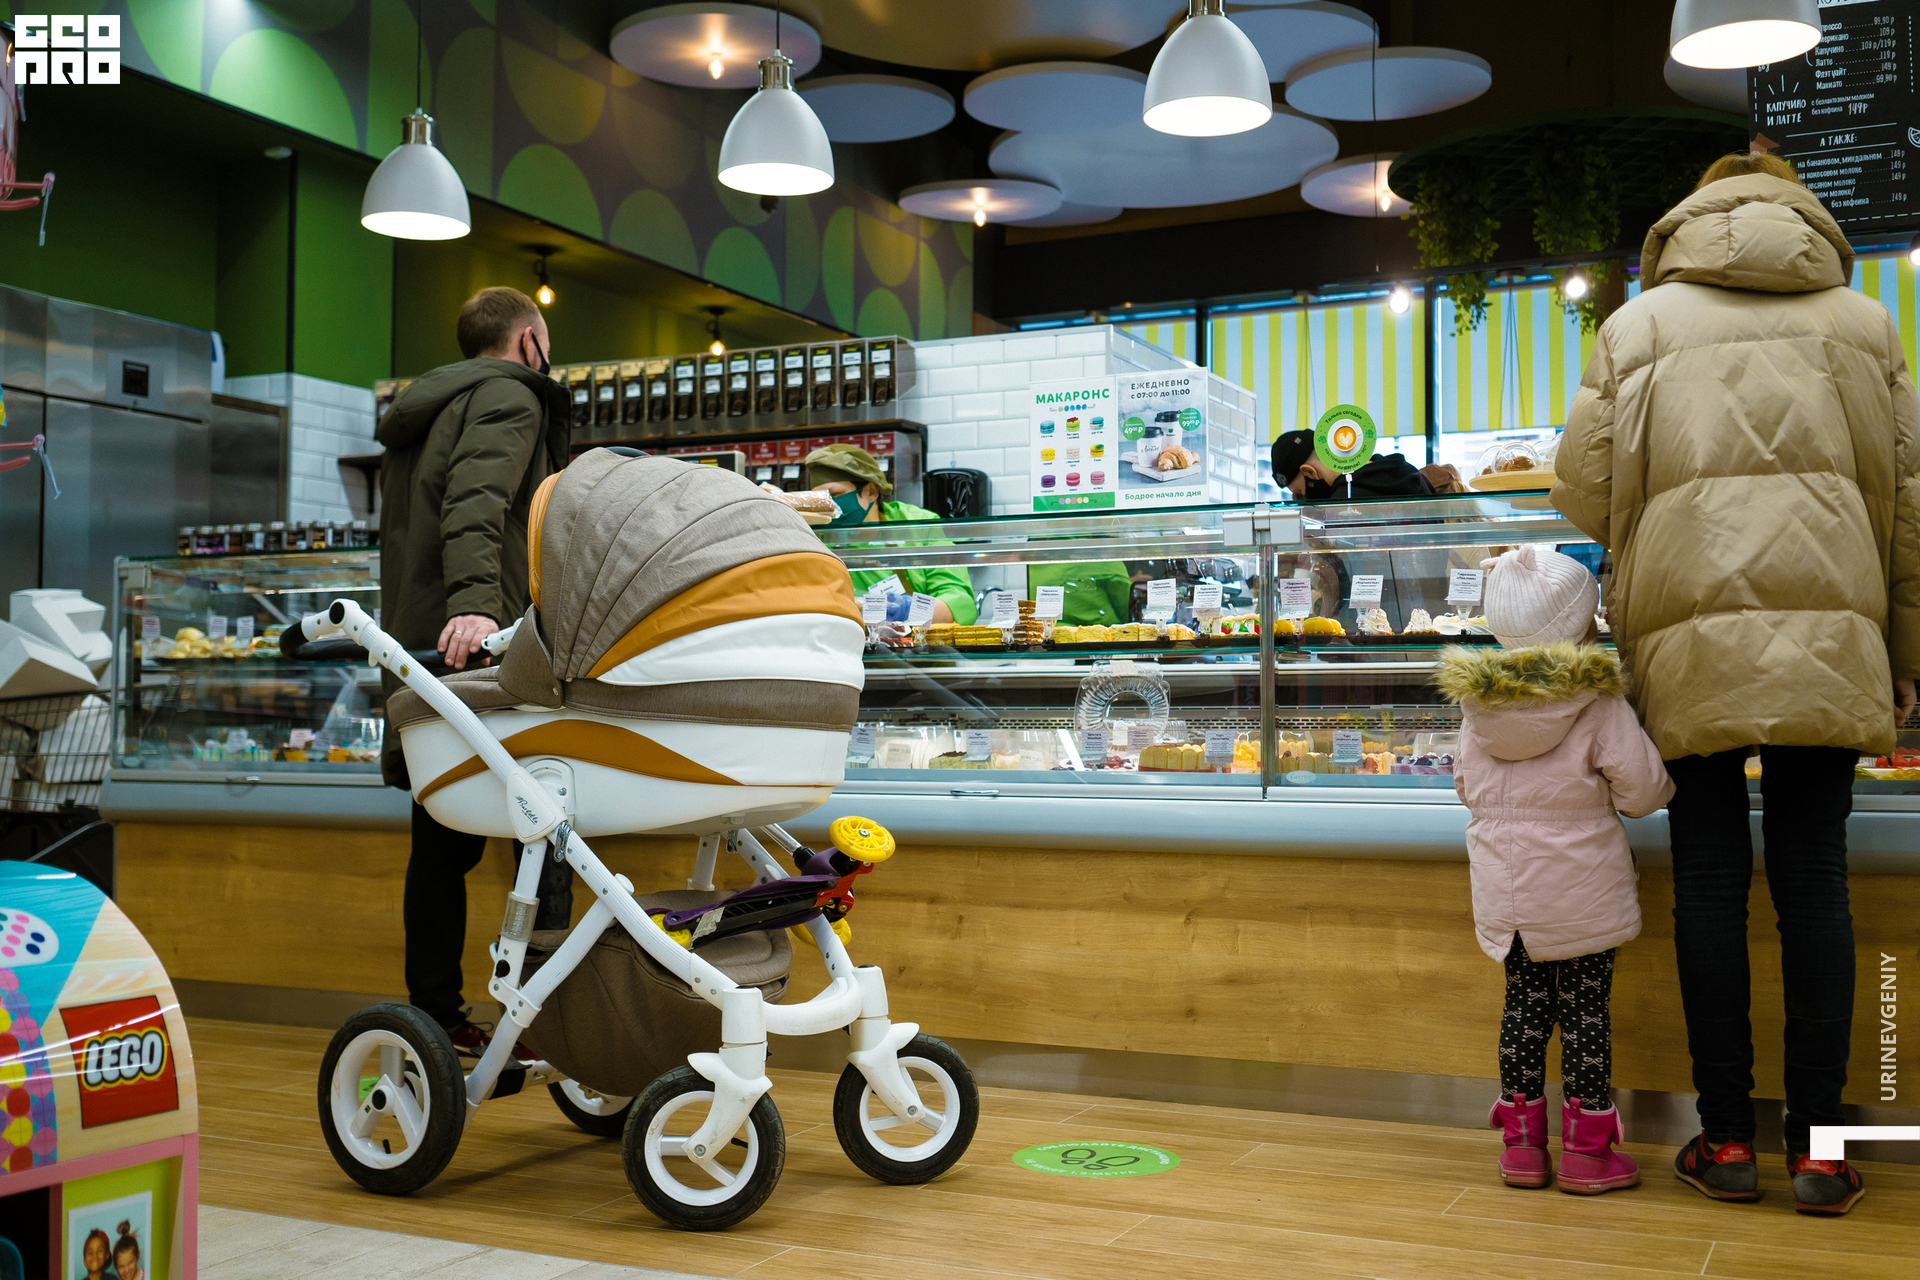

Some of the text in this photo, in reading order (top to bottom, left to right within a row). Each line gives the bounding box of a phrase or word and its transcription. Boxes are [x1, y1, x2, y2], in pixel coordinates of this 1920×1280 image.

[1820, 34, 1849, 43] мерикано
[1815, 46, 1844, 56] Капучино
[1816, 58, 1833, 66] Латте
[1815, 70, 1830, 78] Флэт
[1832, 67, 1847, 78] уайт
[1817, 81, 1842, 90] Макиато
[1766, 99, 1807, 113] КАПУЧИНО
[1767, 113, 1802, 126] И ЛАТТЕ
[1820, 133, 1857, 147] А ТАКЖЕ:
[1807, 169, 1838, 179] кокосовом
[1840, 167, 1862, 175] молоке
[1834, 179, 1856, 187] молоке
[1831, 200, 1842, 208] без
[1843, 198, 1869, 207] кофеина
[1131, 379, 1190, 390] ЕЖЕДНЕВНО
[1036, 388, 1110, 404] МАКАРОНС
[1186, 490, 1202, 498] дня
[84, 1029, 164, 1087] LEGO
